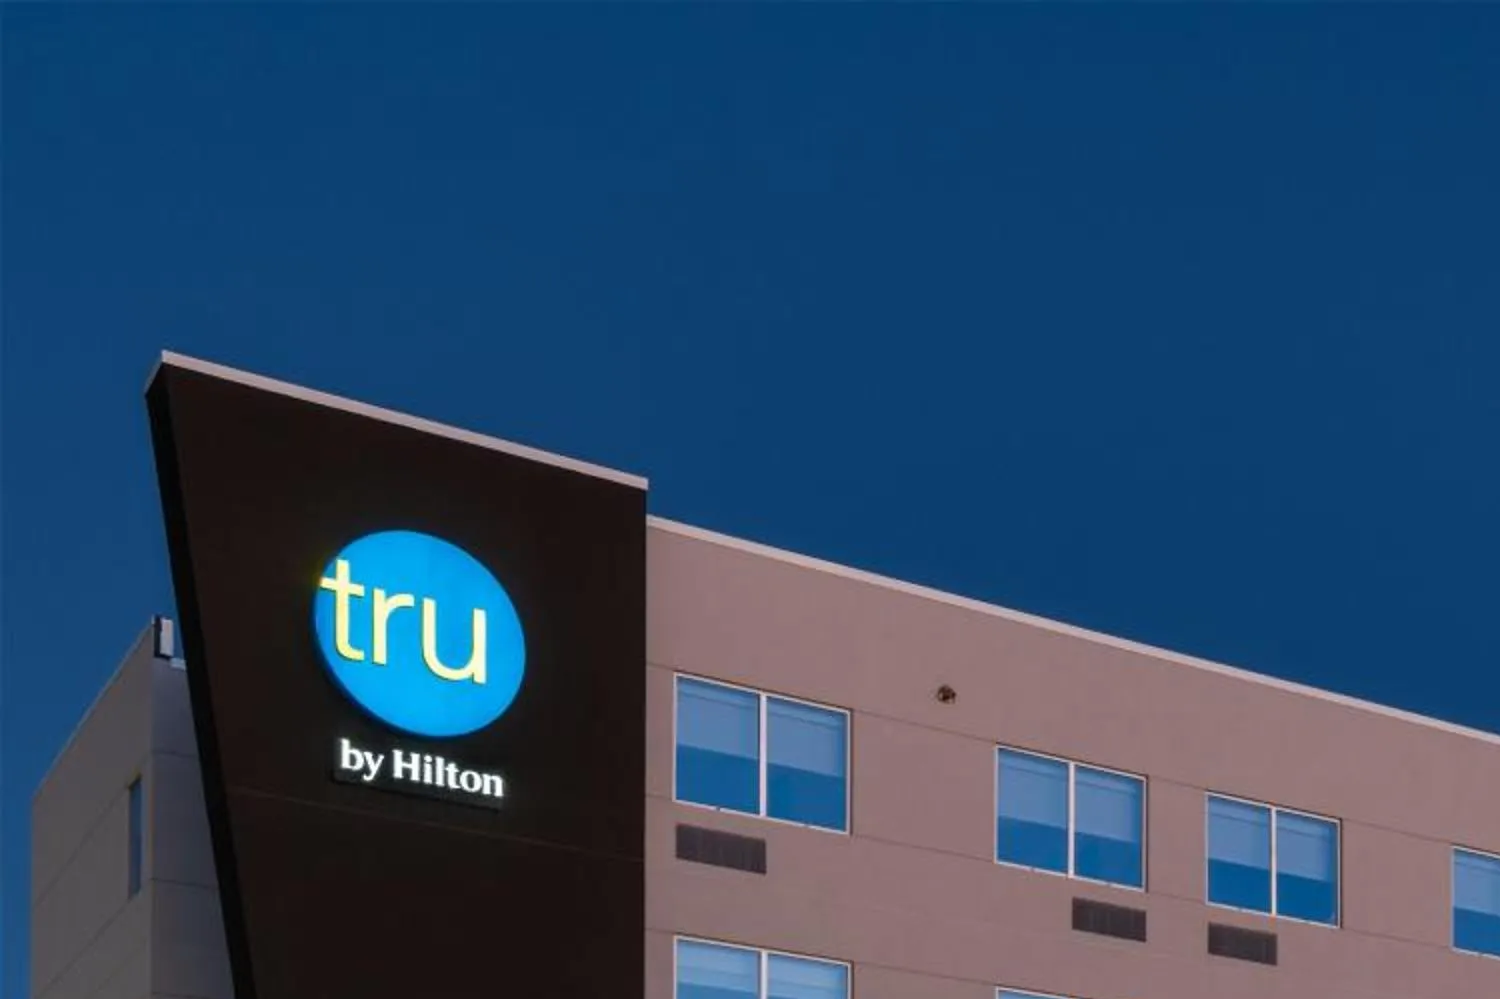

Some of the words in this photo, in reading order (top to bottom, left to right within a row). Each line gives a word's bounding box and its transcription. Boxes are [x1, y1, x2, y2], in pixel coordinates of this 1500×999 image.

[319, 559, 487, 685] tru
[340, 737, 385, 782] by
[392, 749, 504, 797] Hilton
